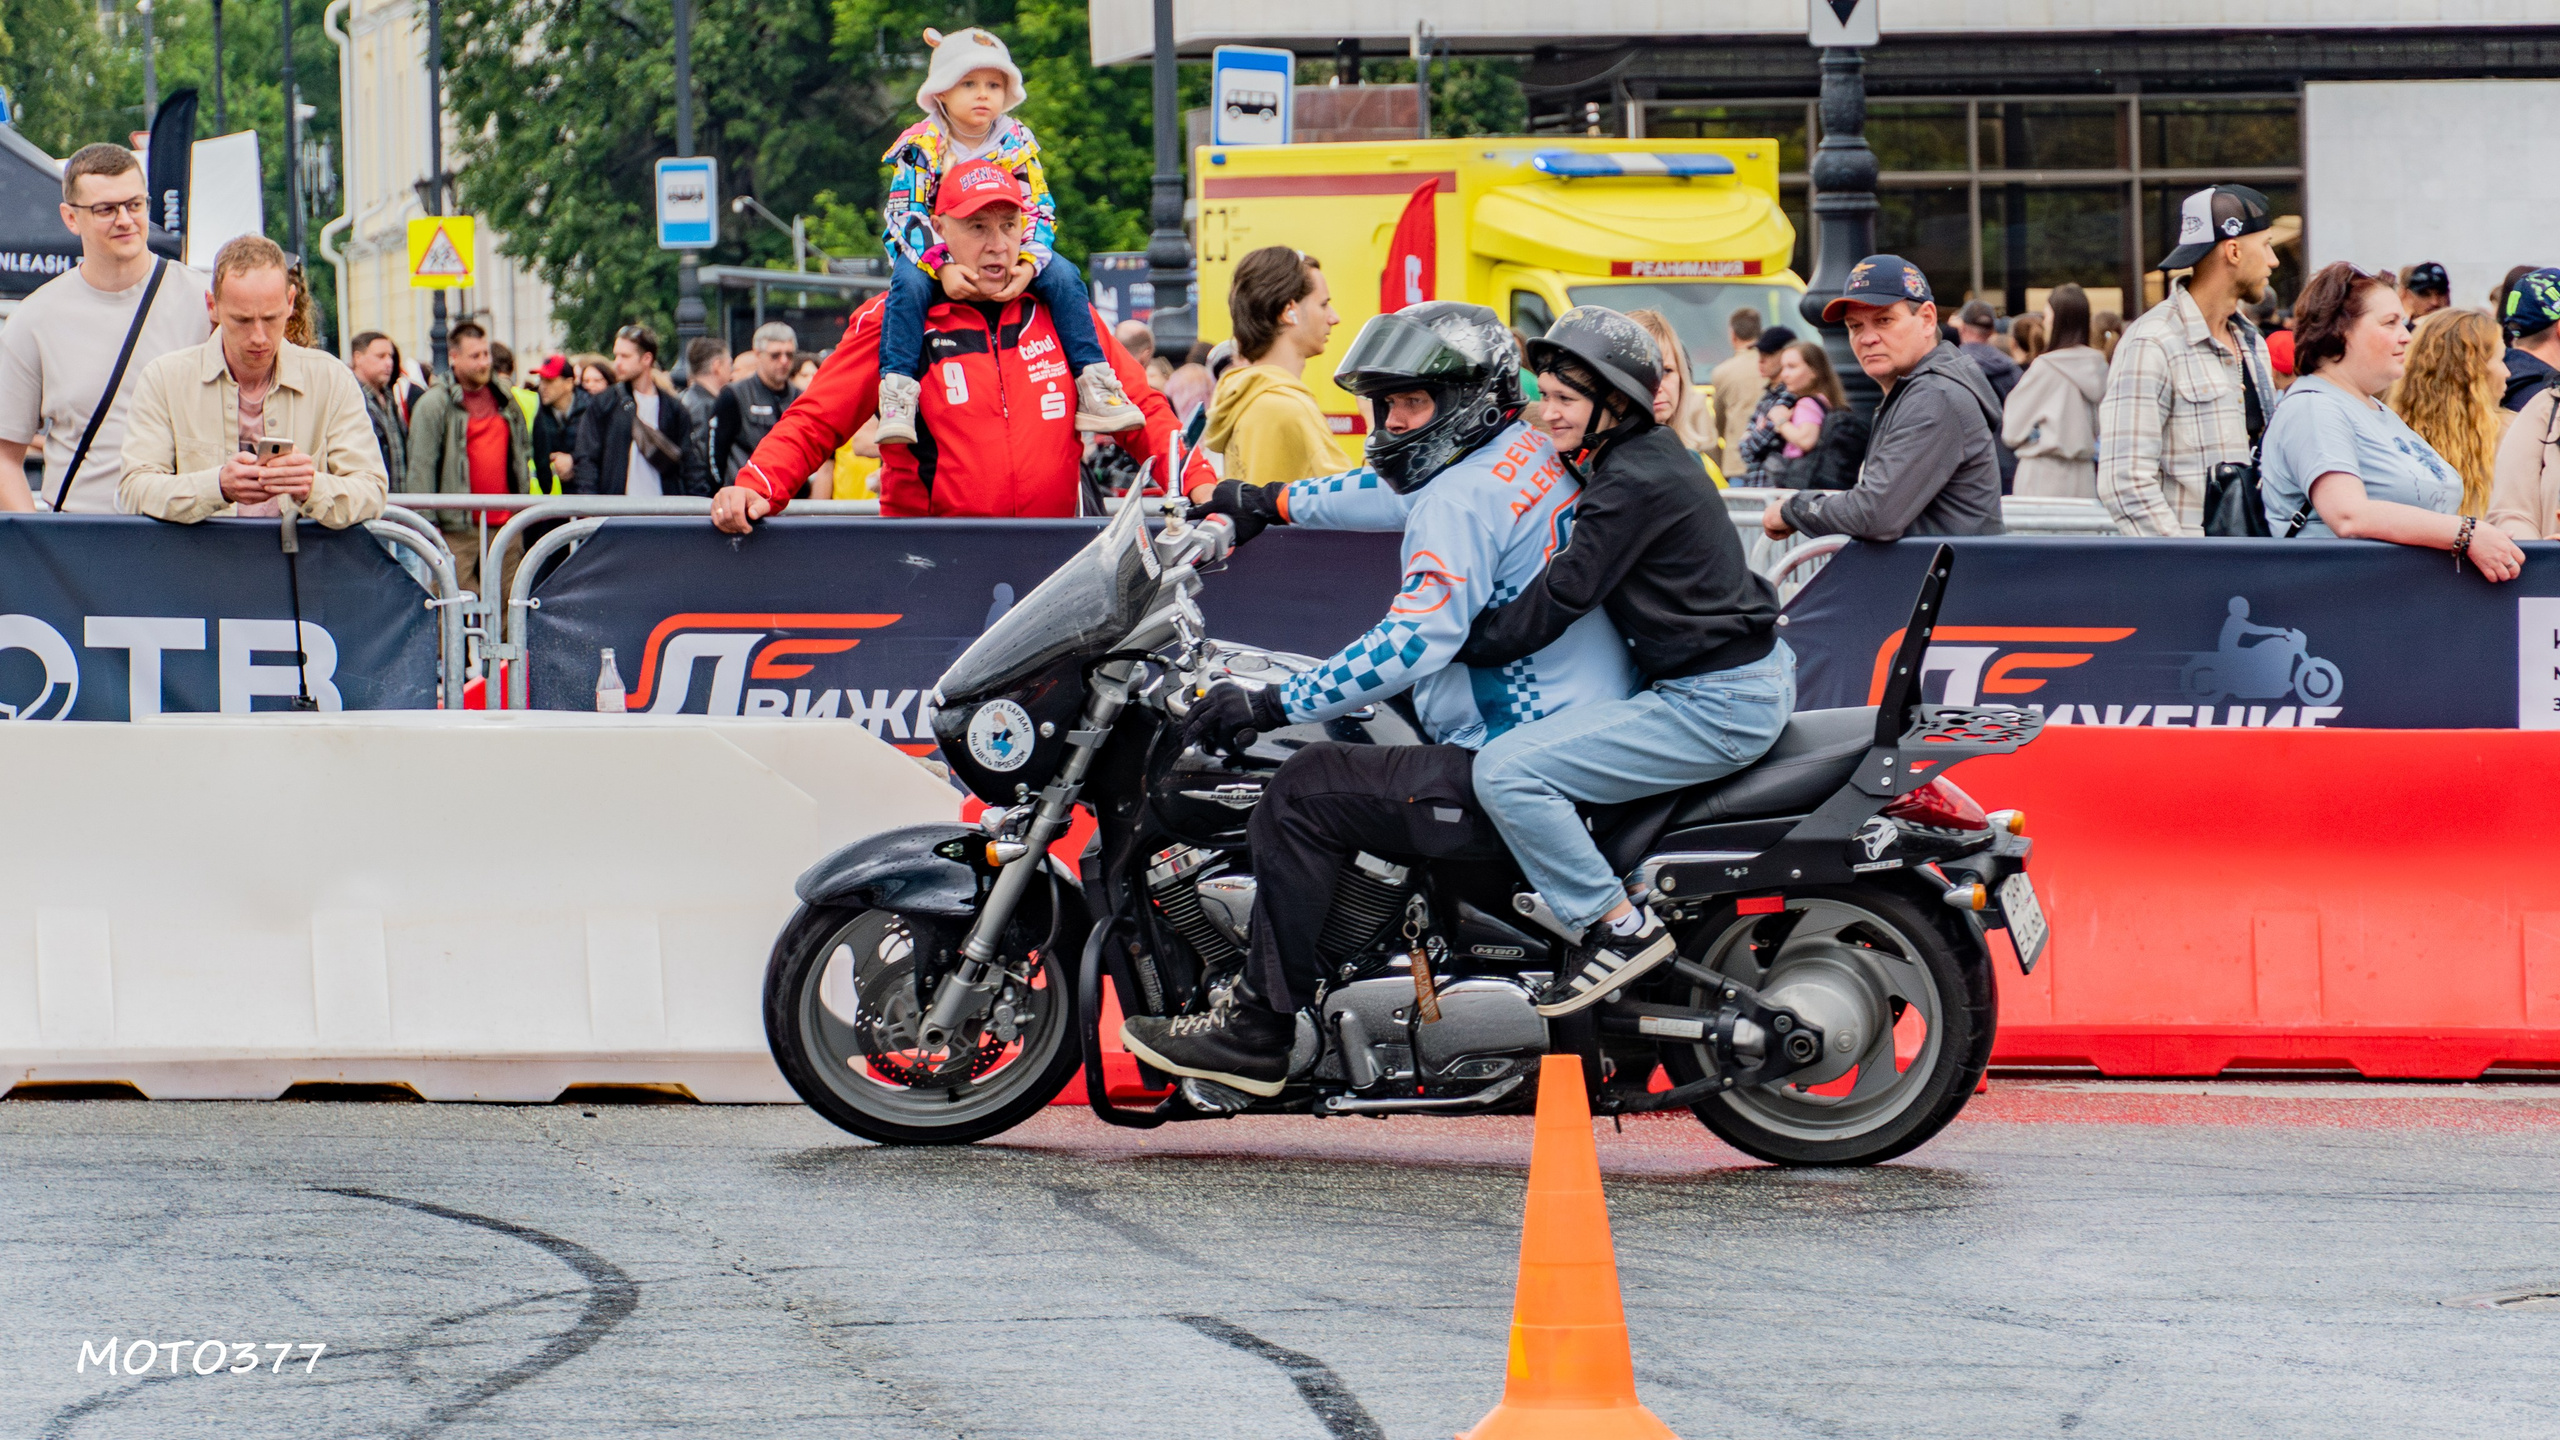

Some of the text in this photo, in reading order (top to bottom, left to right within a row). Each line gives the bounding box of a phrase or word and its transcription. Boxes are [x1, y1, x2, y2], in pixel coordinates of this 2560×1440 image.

[1631, 260, 1745, 277] РЕАНИМАЦИЯ
[1018, 334, 1057, 361] tebu!
[942, 361, 969, 405] 9
[1510, 452, 1567, 526] ALEKS
